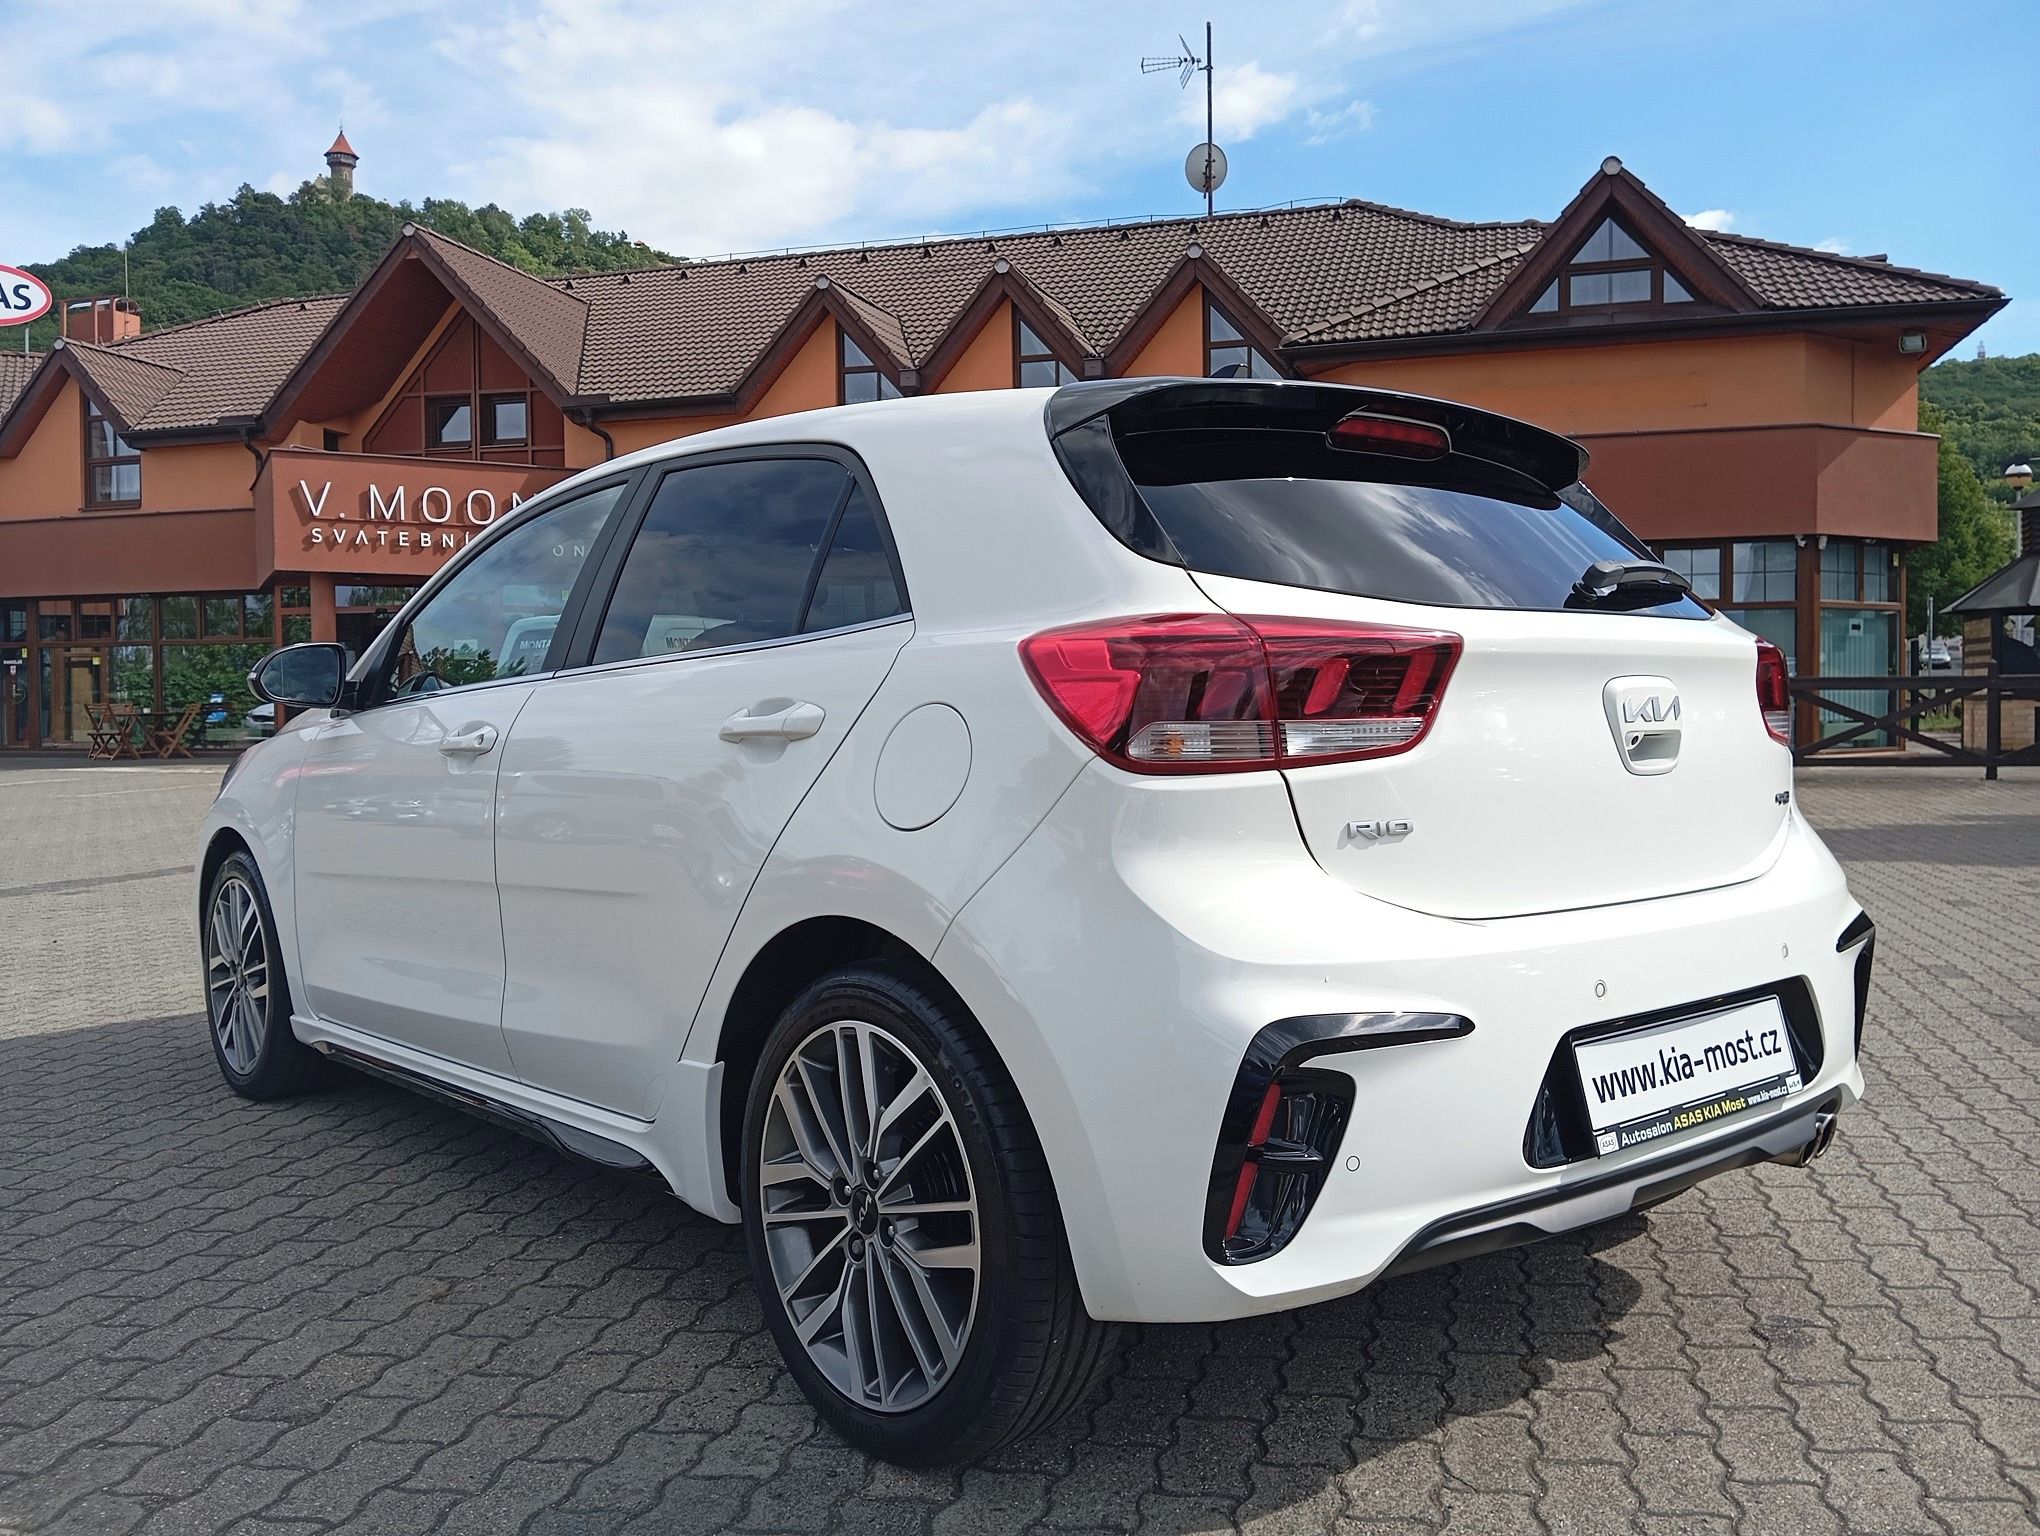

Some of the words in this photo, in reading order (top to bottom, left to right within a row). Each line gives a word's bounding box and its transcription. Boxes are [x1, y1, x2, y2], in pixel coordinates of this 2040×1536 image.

[300, 480, 345, 518] V.
[1623, 695, 1681, 723] KIA
[1346, 819, 1413, 840] RIO
[1592, 1029, 1782, 1104] www.kia-most.cz
[1621, 1121, 1673, 1147] Autosalon
[1674, 1109, 1703, 1130] ASAS
[1702, 1103, 1722, 1120] KIA
[1721, 1097, 1746, 1115] Most
